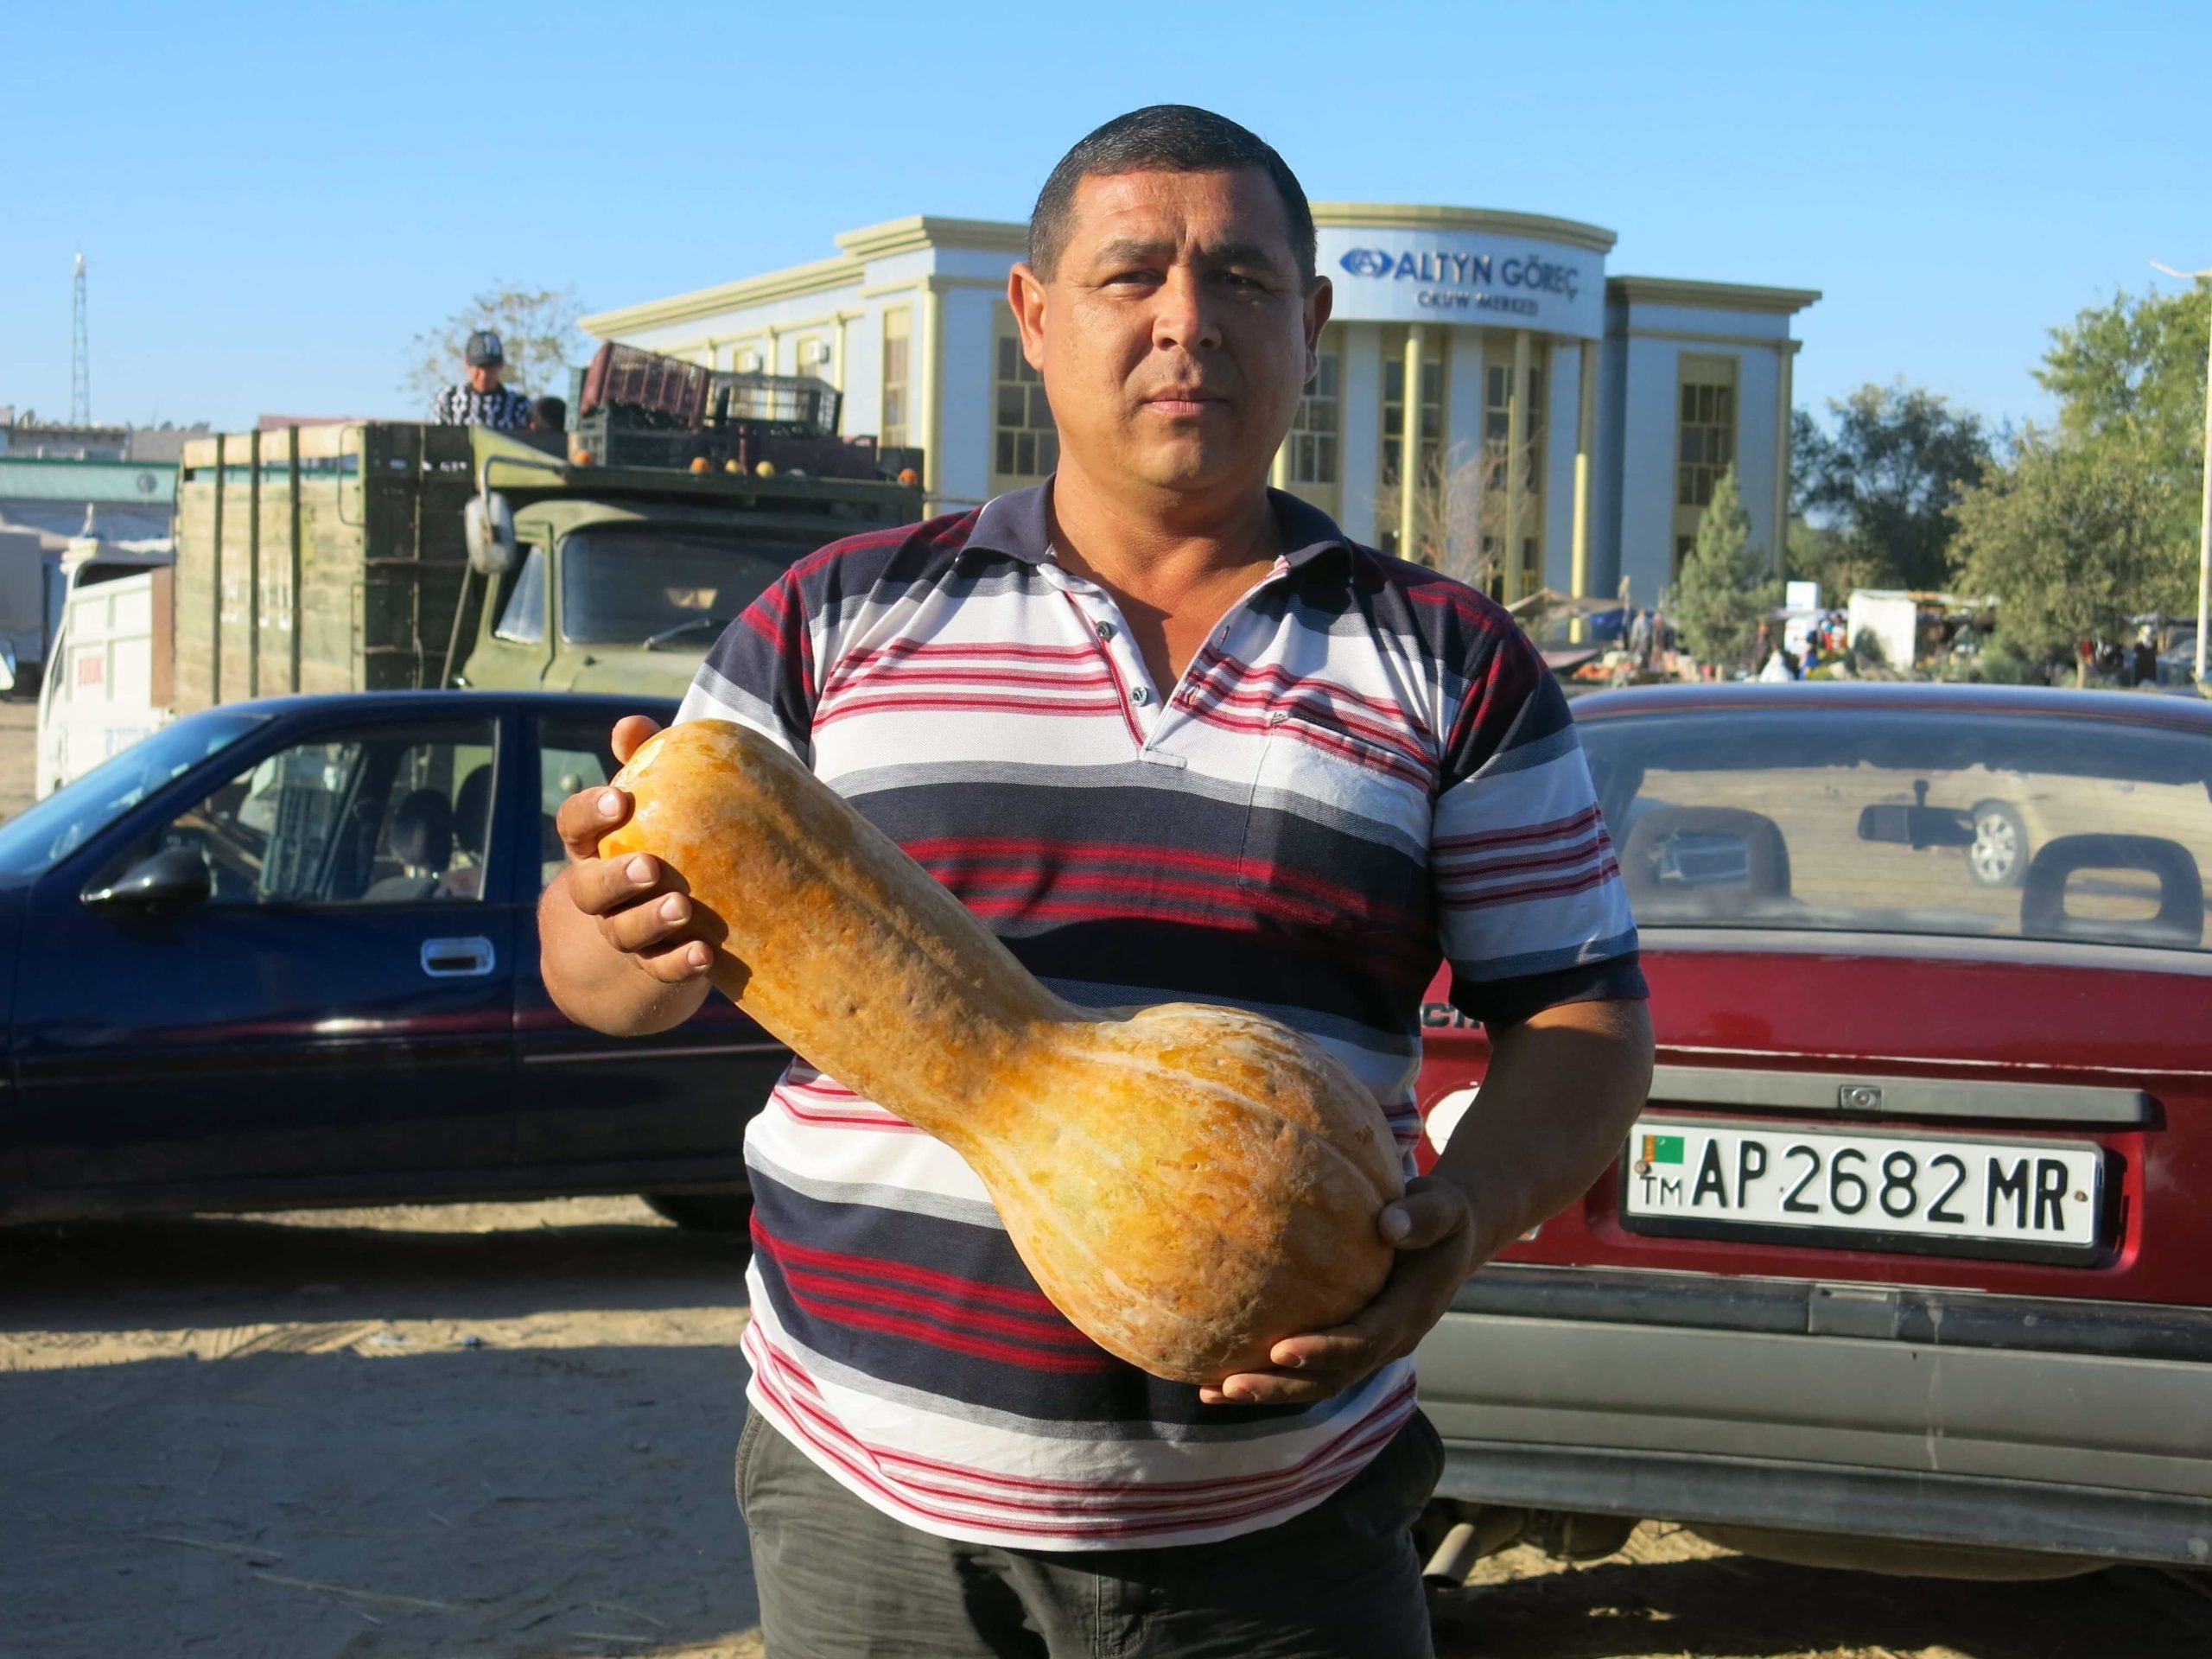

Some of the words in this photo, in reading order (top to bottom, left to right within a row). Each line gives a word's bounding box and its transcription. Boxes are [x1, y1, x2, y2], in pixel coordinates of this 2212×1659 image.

[1394, 250, 1492, 286] ALTYN
[1502, 254, 1580, 302] GÖREÇ
[1638, 1174, 1682, 1206] TM
[1691, 1137, 1768, 1209] AP
[1778, 1144, 1967, 1224] 2682
[1986, 1156, 2069, 1231] MR
